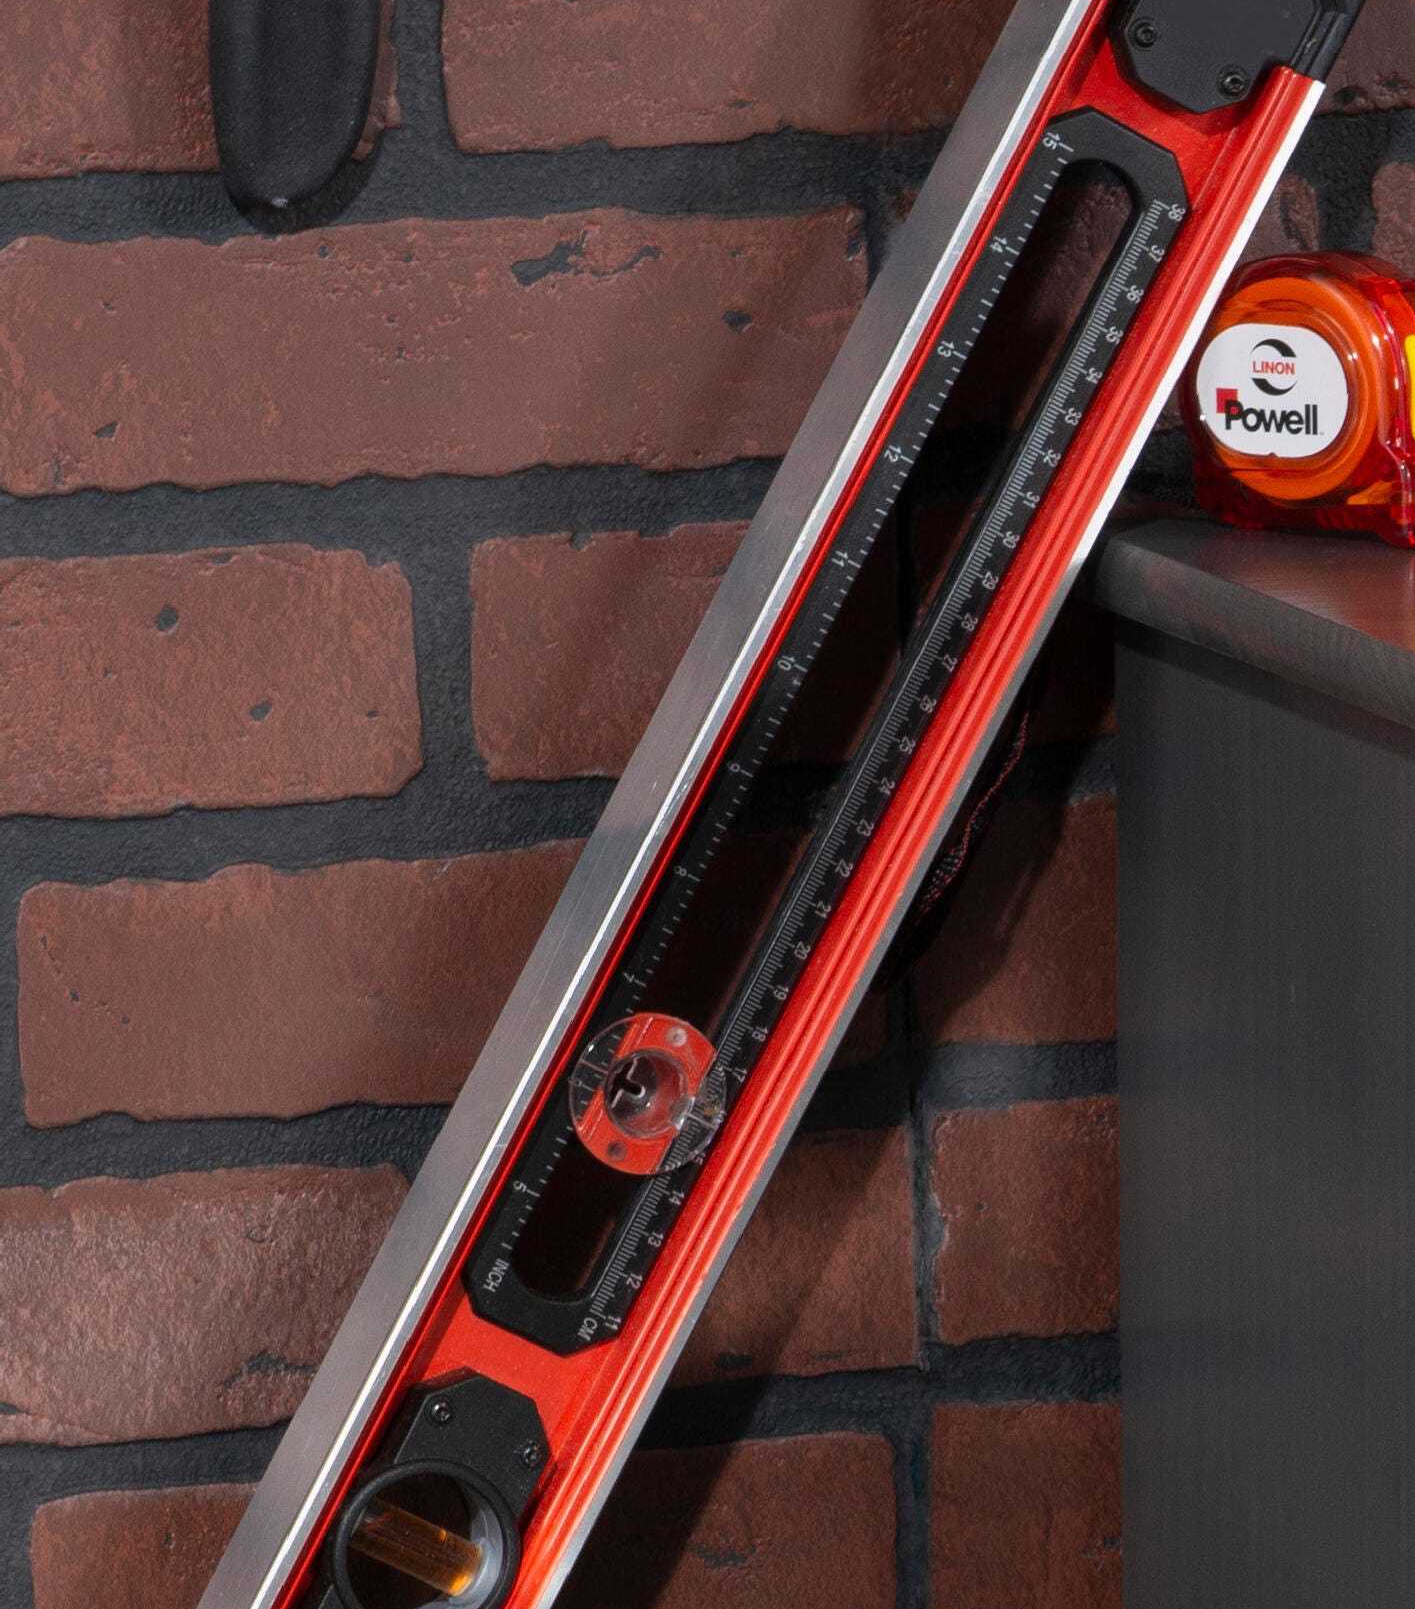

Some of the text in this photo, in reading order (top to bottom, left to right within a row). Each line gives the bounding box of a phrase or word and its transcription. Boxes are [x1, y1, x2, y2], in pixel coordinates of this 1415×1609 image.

[1043, 130, 1060, 150] 15
[1167, 203, 1185, 222] 38
[990, 235, 1009, 254] 14
[1148, 243, 1165, 262] 37
[1126, 285, 1145, 305] 36
[1104, 326, 1123, 345] 35
[937, 339, 955, 357] 13
[1084, 367, 1103, 386] 34
[1252, 361, 1295, 375] LINON
[1065, 407, 1082, 426] 33
[1225, 400, 1317, 435] Powell
[884, 443, 900, 462] 12
[1043, 448, 1061, 467] 32
[1024, 491, 1039, 508] 31
[1002, 530, 1020, 550] 30
[832, 551, 849, 569] 11
[981, 570, 999, 590] 29
[961, 613, 978, 632] 28
[777, 654, 796, 672] 10
[919, 694, 937, 714] 26
[898, 737, 916, 756] 25
[878, 778, 896, 797] 24
[856, 820, 874, 837] 23
[835, 860, 853, 878] 22
[794, 942, 811, 960] 20
[752, 1026, 769, 1043] 18
[649, 1231, 666, 1249] 13
[486, 1259, 511, 1294] INCH
[627, 1271, 644, 1290] 12
[576, 1316, 599, 1342] CM
